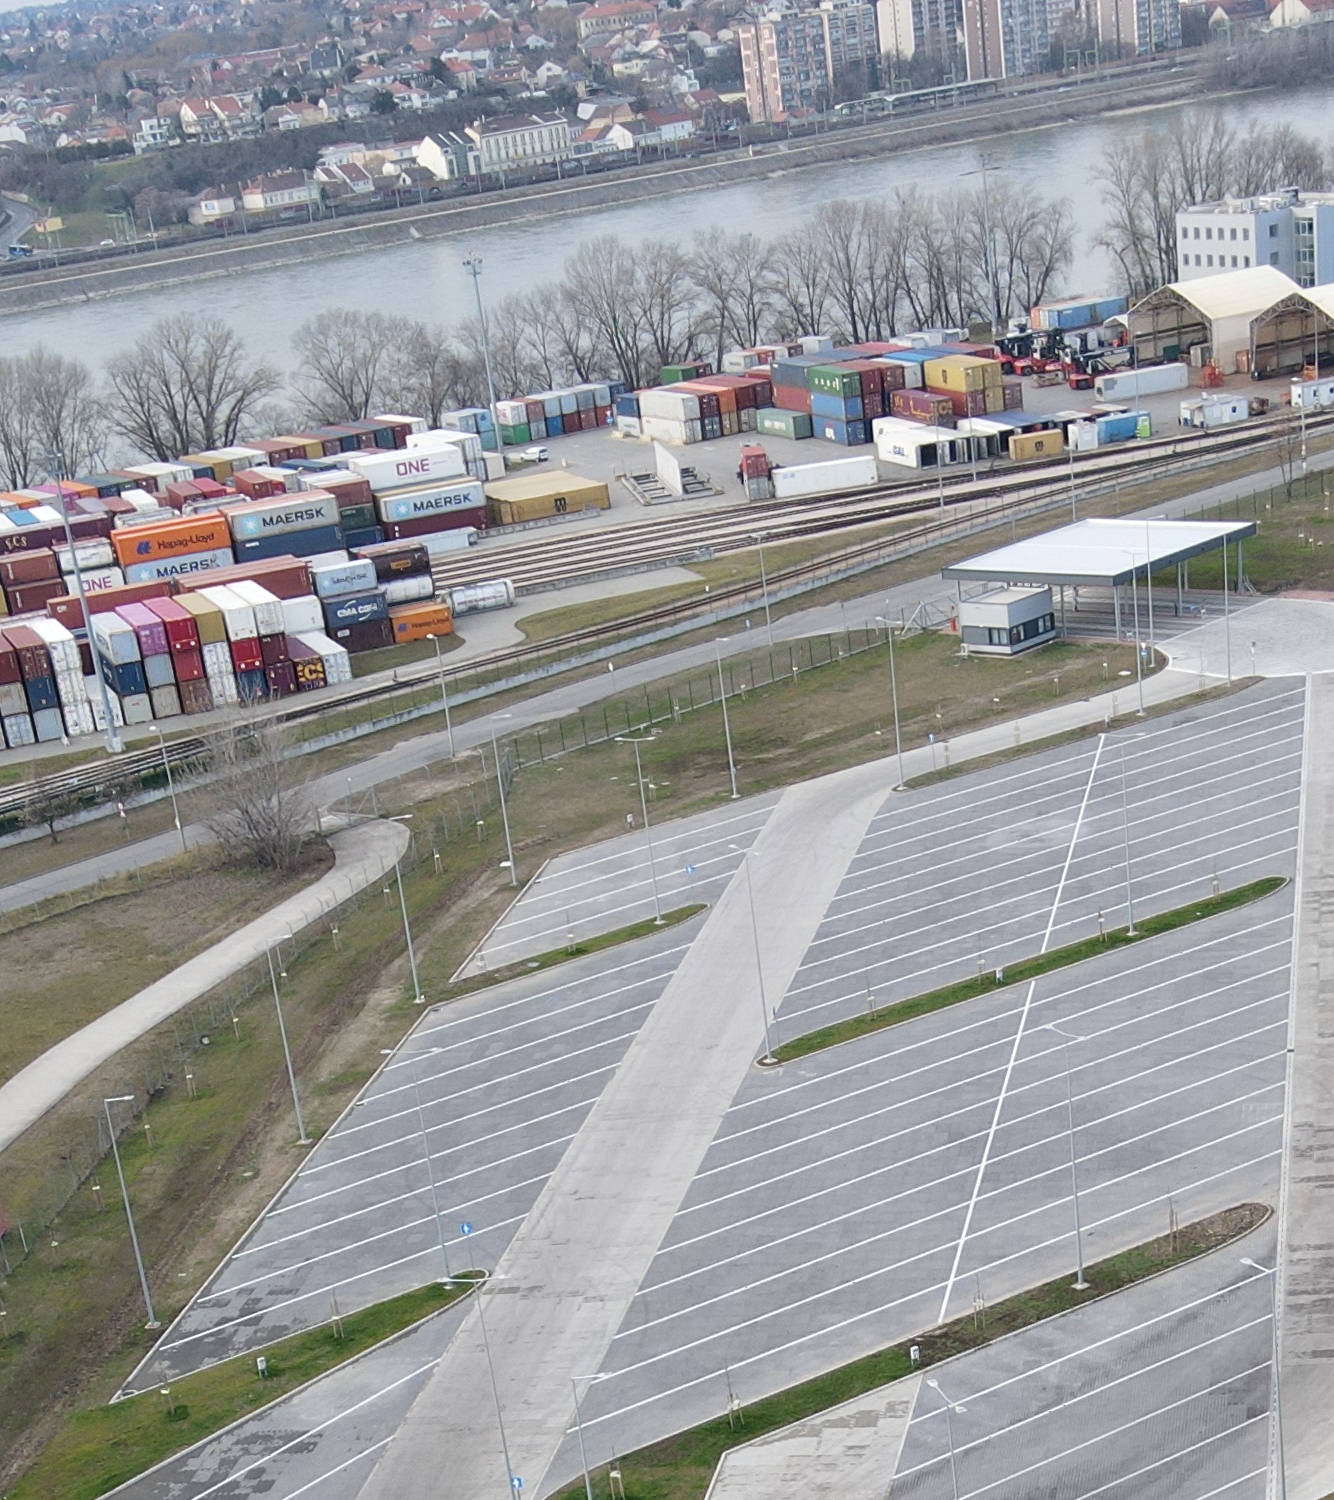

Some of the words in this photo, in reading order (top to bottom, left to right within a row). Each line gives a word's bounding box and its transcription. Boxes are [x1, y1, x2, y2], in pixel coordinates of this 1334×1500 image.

[396, 458, 430, 476] ONE
[413, 492, 473, 512] MAERSK
[261, 507, 325, 527] MAERSK
